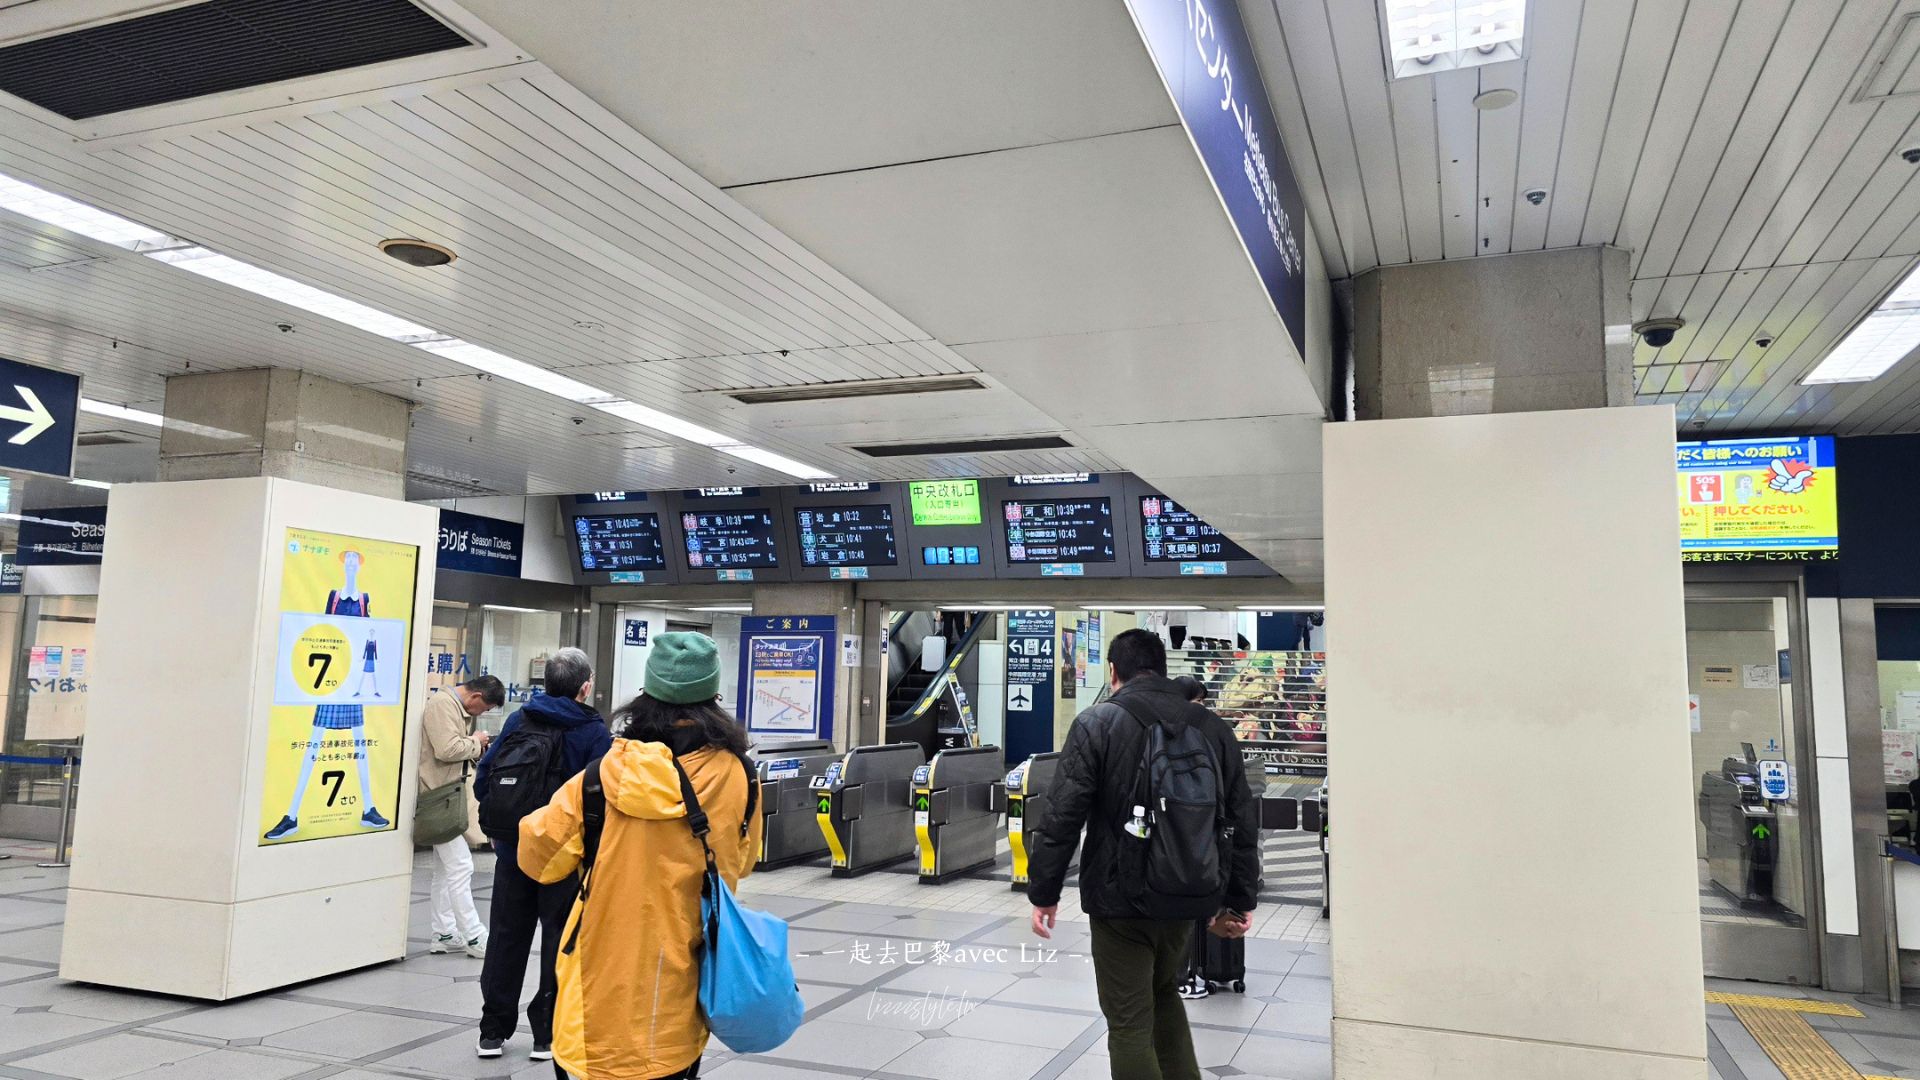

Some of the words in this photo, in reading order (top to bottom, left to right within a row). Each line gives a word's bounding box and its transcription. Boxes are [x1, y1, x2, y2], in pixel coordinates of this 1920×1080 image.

[1186, 0, 1244, 132] センター
[1696, 476, 1715, 485] SOS
[913, 483, 975, 498] 中央改札口
[1025, 507, 1053, 517] 河和
[1056, 504, 1075, 516] 10:39
[1714, 505, 1809, 517] 押してください。
[1058, 529, 1077, 539] 10:43
[1165, 525, 1196, 535] 豊明
[471, 532, 493, 547] Season
[492, 536, 512, 551] Tickets
[1060, 546, 1079, 556] 10:49
[1167, 544, 1197, 554] 東岡崎
[1201, 543, 1221, 554] 10:37
[924, 547, 979, 564] 10:32
[765, 618, 809, 629] ご案内
[626, 626, 647, 639] 名鉄
[1041, 640, 1052, 656] 4
